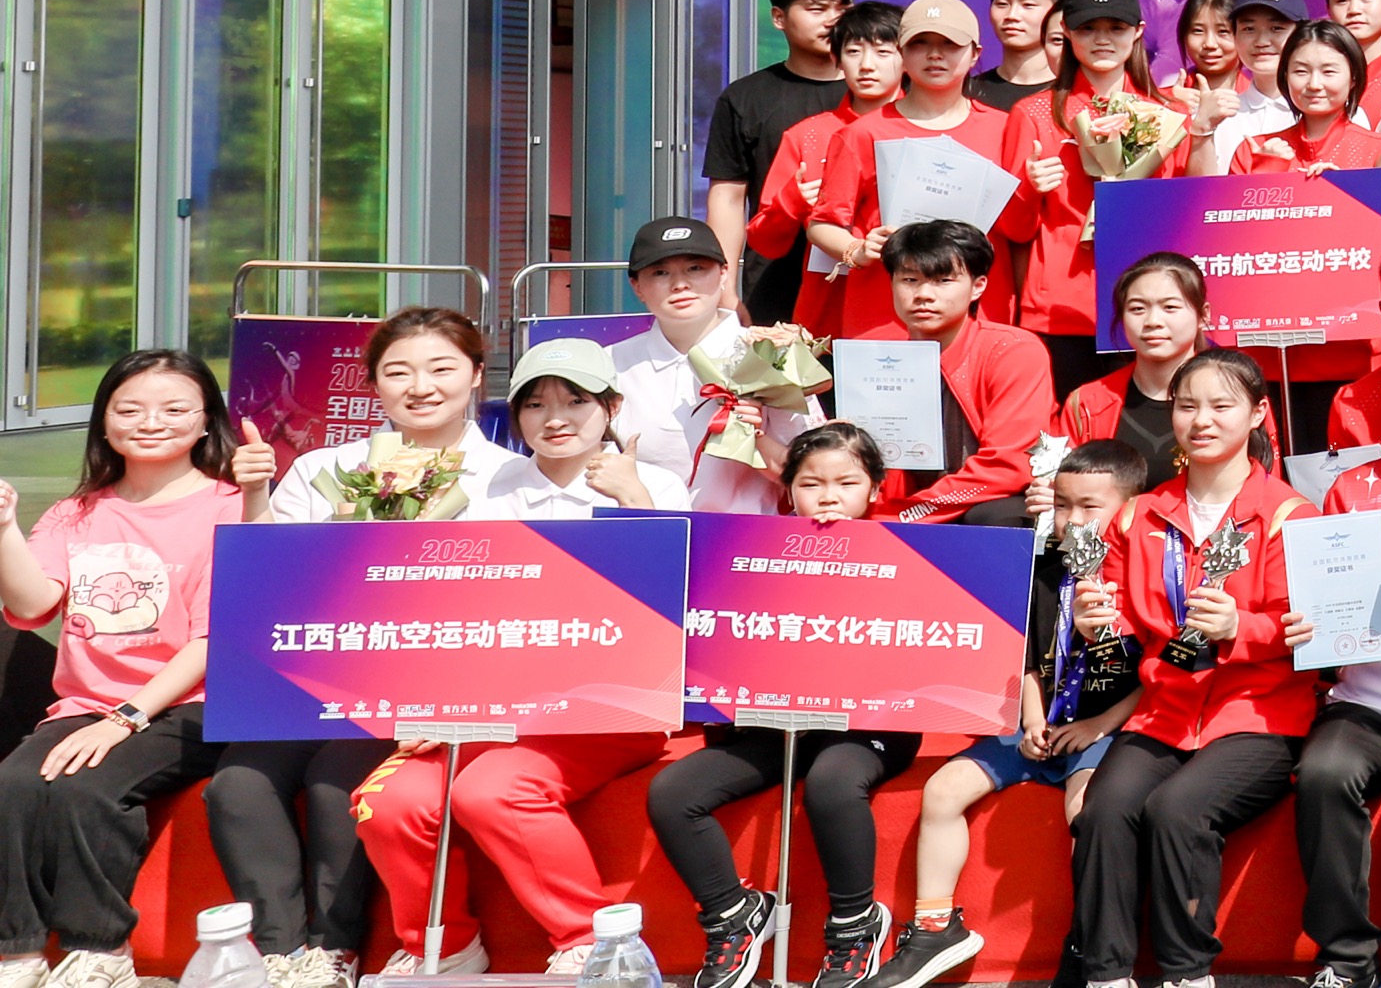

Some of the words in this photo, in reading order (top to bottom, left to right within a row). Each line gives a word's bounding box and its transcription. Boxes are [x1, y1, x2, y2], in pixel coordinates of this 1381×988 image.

[1242, 187, 1294, 208] 2024
[328, 363, 371, 392] 202
[898, 501, 938, 524] CHINA
[418, 539, 492, 564] 2024
[781, 534, 850, 559] 2024
[1330, 541, 1345, 549] ASFC
[364, 564, 543, 582] 全国室内跳伞冠军赛
[730, 556, 898, 579] 全国室内跳伞冠军赛
[1326, 564, 1355, 575] 获奖证书
[271, 618, 624, 653] 江西省航空运动管理中心
[685, 607, 985, 651] 畅飞体育文化有限公司
